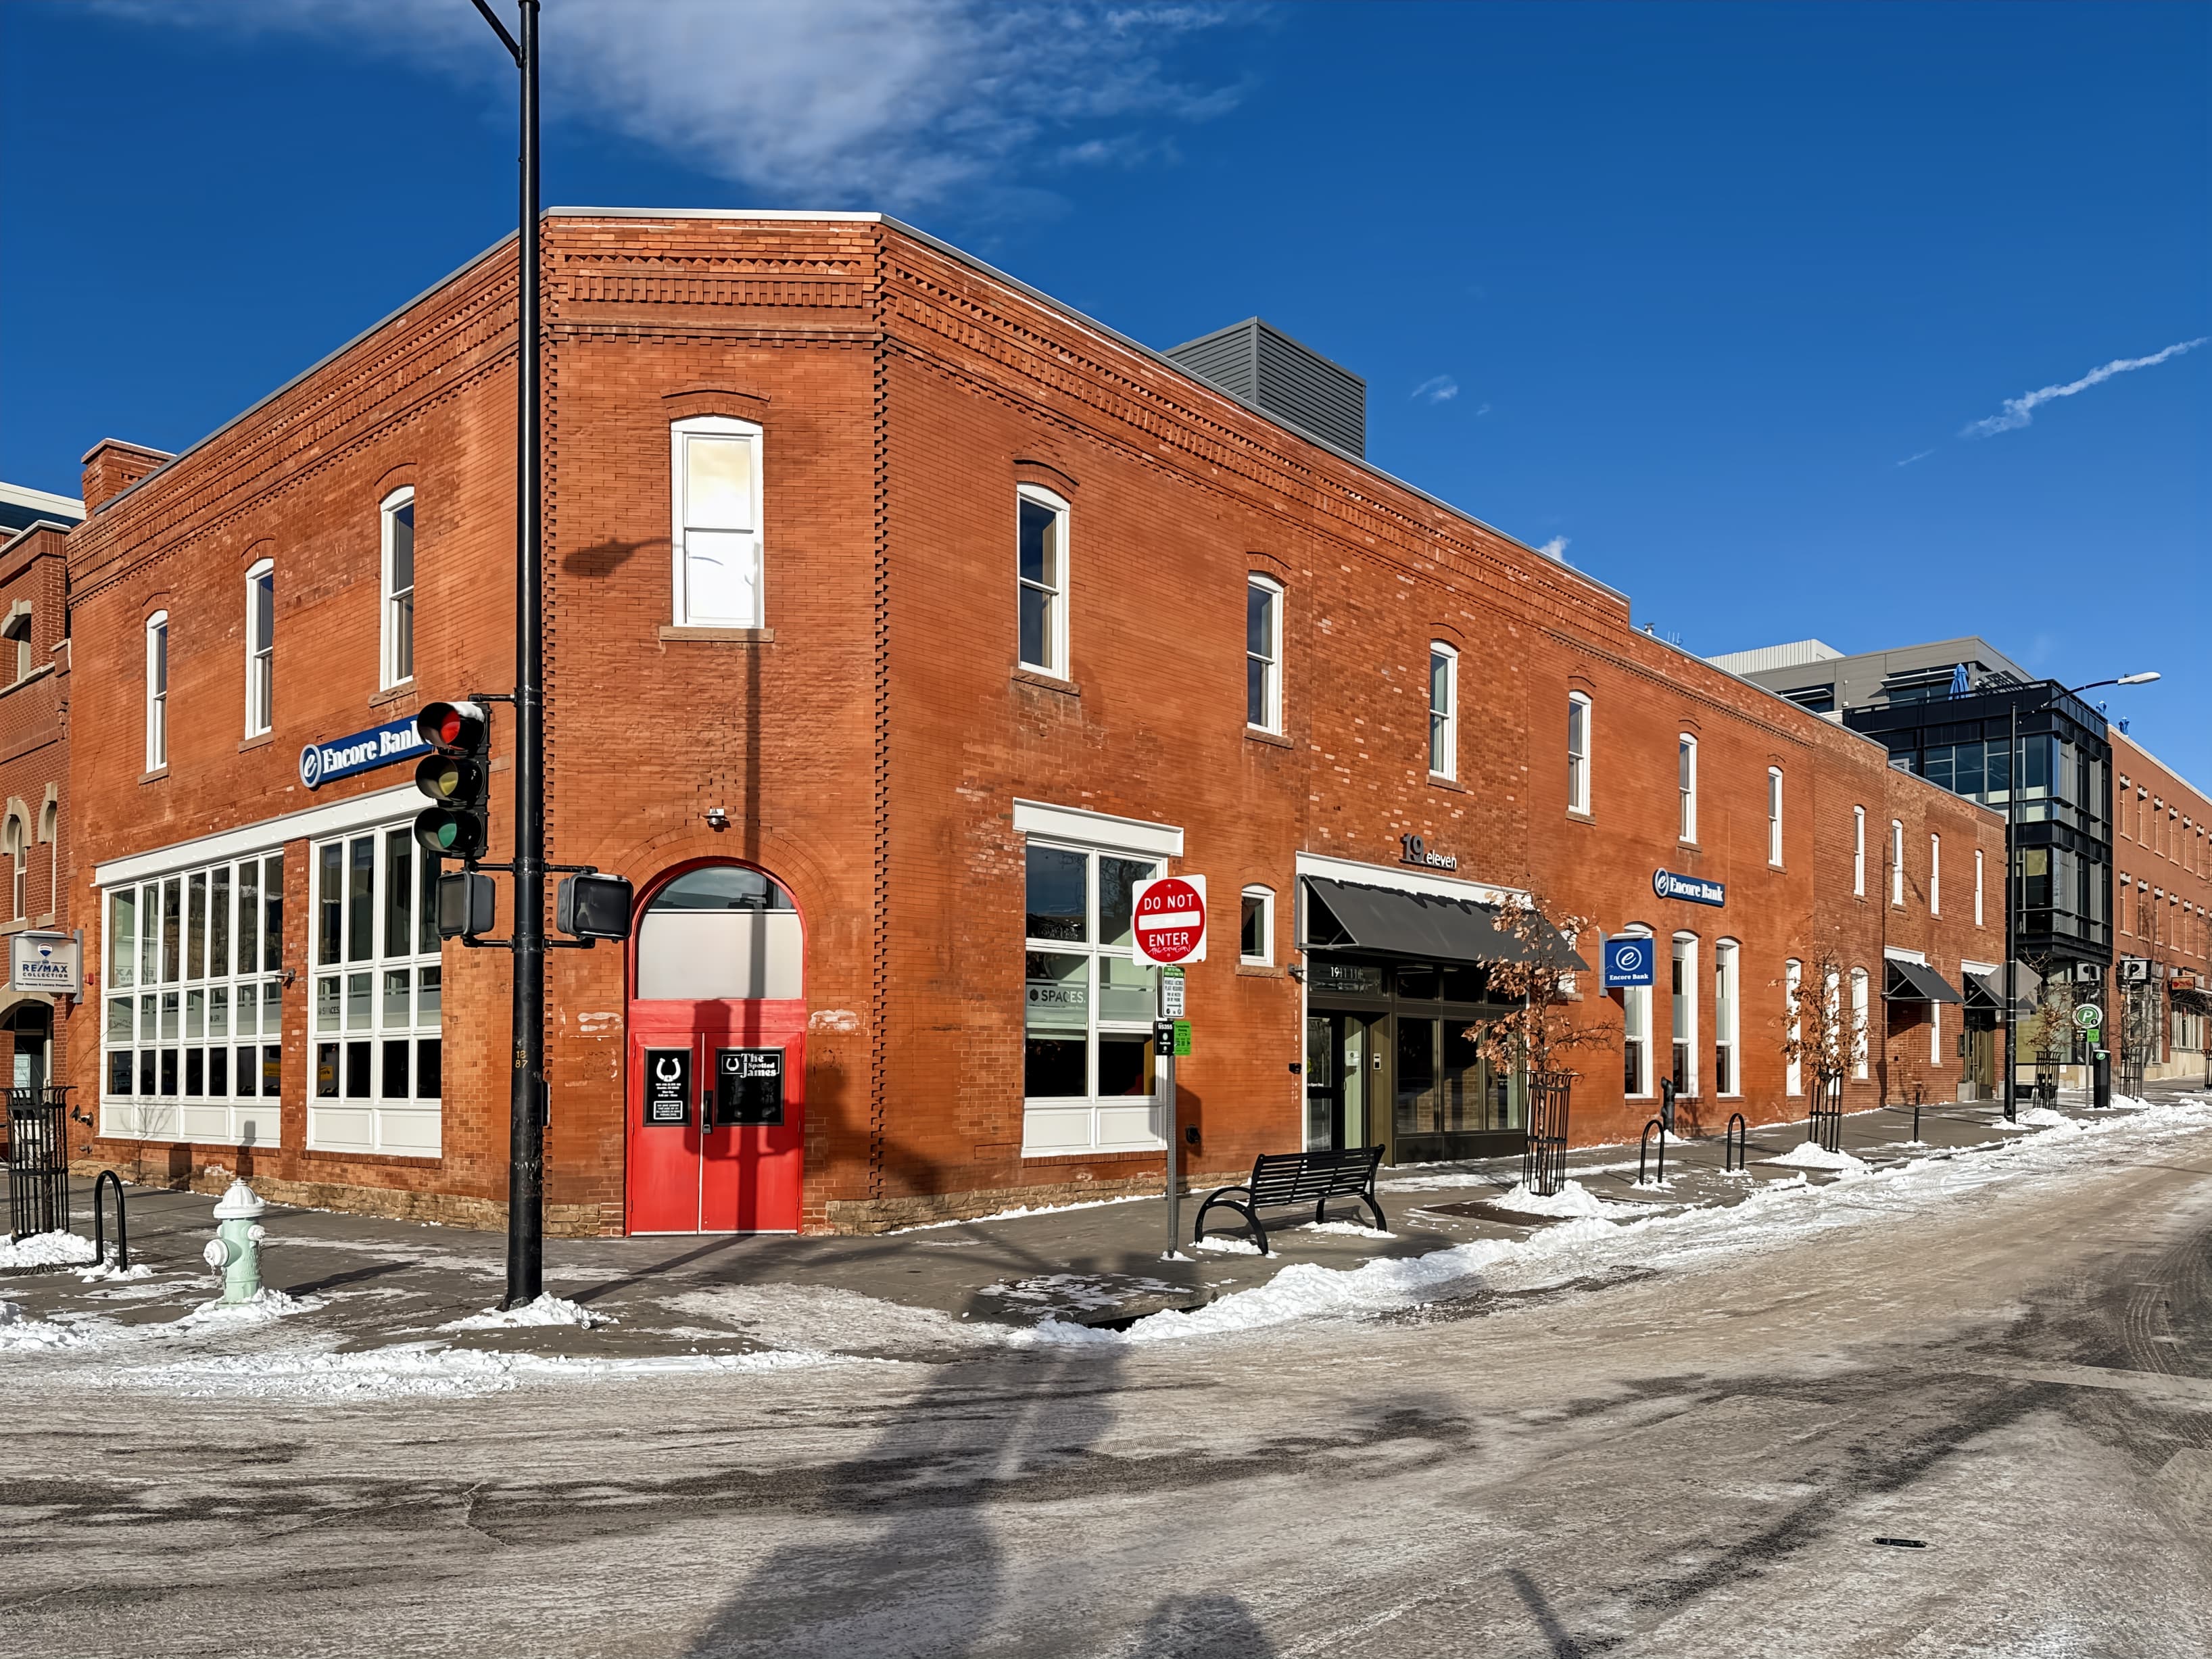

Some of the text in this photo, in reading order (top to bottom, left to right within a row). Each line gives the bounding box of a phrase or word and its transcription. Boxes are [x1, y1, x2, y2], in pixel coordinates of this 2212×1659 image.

[322, 740, 377, 773] Encore
[379, 720, 425, 757] Bank
[1400, 833, 1457, 869] 19 eleven
[1669, 877, 1701, 897] Encore
[1701, 884, 1723, 902] Bank
[1144, 893, 1194, 911] DO NOT
[1149, 932, 1189, 947] ENTER
[22, 963, 68, 973] RE/MAX
[2082, 1010, 2094, 1022] P
[515, 1059, 529, 1068] 87
[740, 1053, 764, 1063] The
[740, 1062, 777, 1078] James
